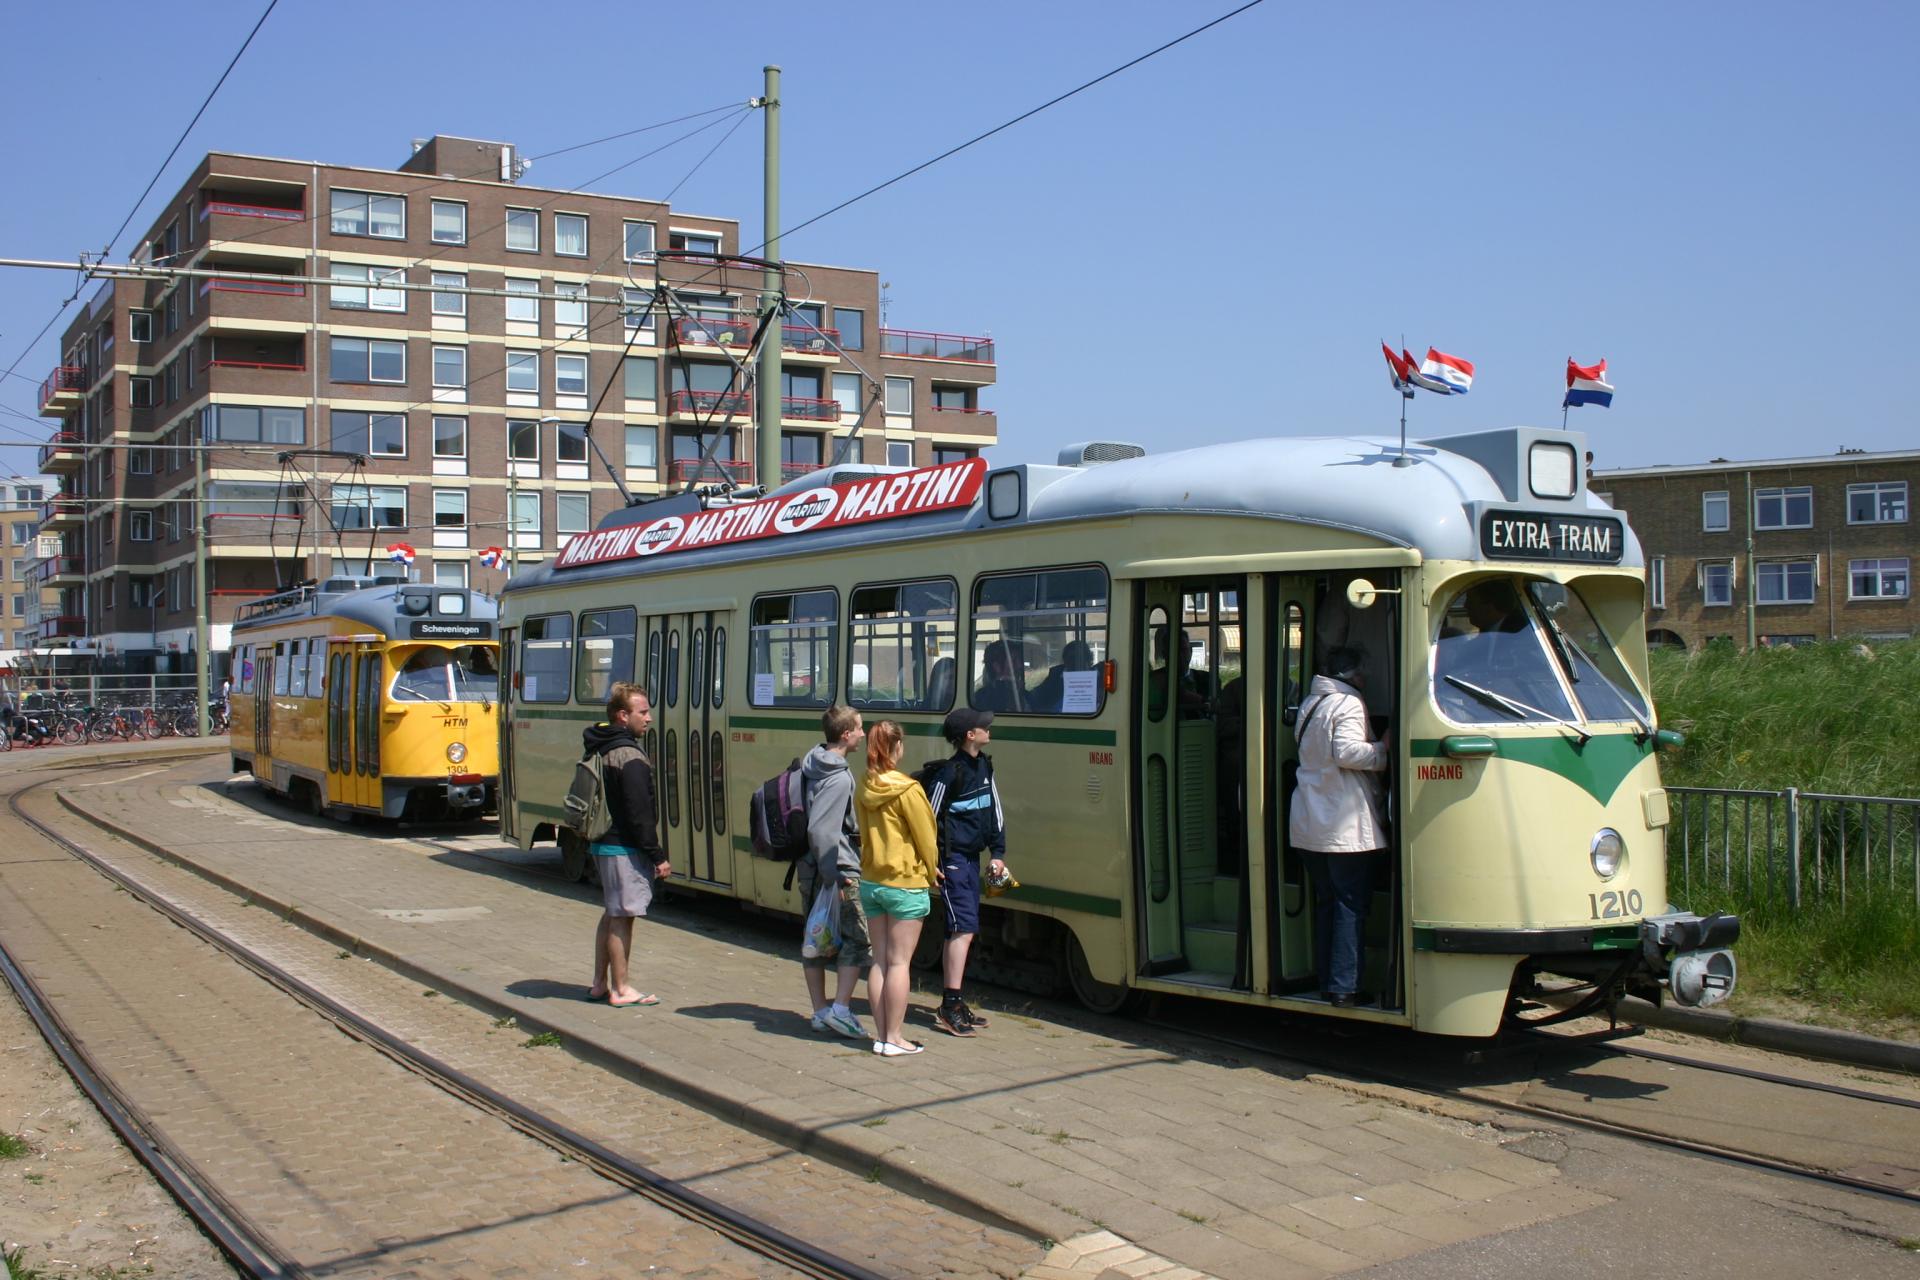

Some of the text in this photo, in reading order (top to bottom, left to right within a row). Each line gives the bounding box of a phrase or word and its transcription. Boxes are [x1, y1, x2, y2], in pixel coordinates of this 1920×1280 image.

[561, 463, 974, 565] MARTINI MARTINI MARTINI MARTINI MARTINI
[1492, 520, 1610, 553] EXTRA TRAM
[421, 624, 480, 635] Scheveningen
[443, 718, 469, 728] HTM
[1089, 751, 1113, 766] INGANG
[446, 765, 468, 775] 1304
[1417, 764, 1463, 780] INGANG
[1588, 888, 1643, 920] 1210
